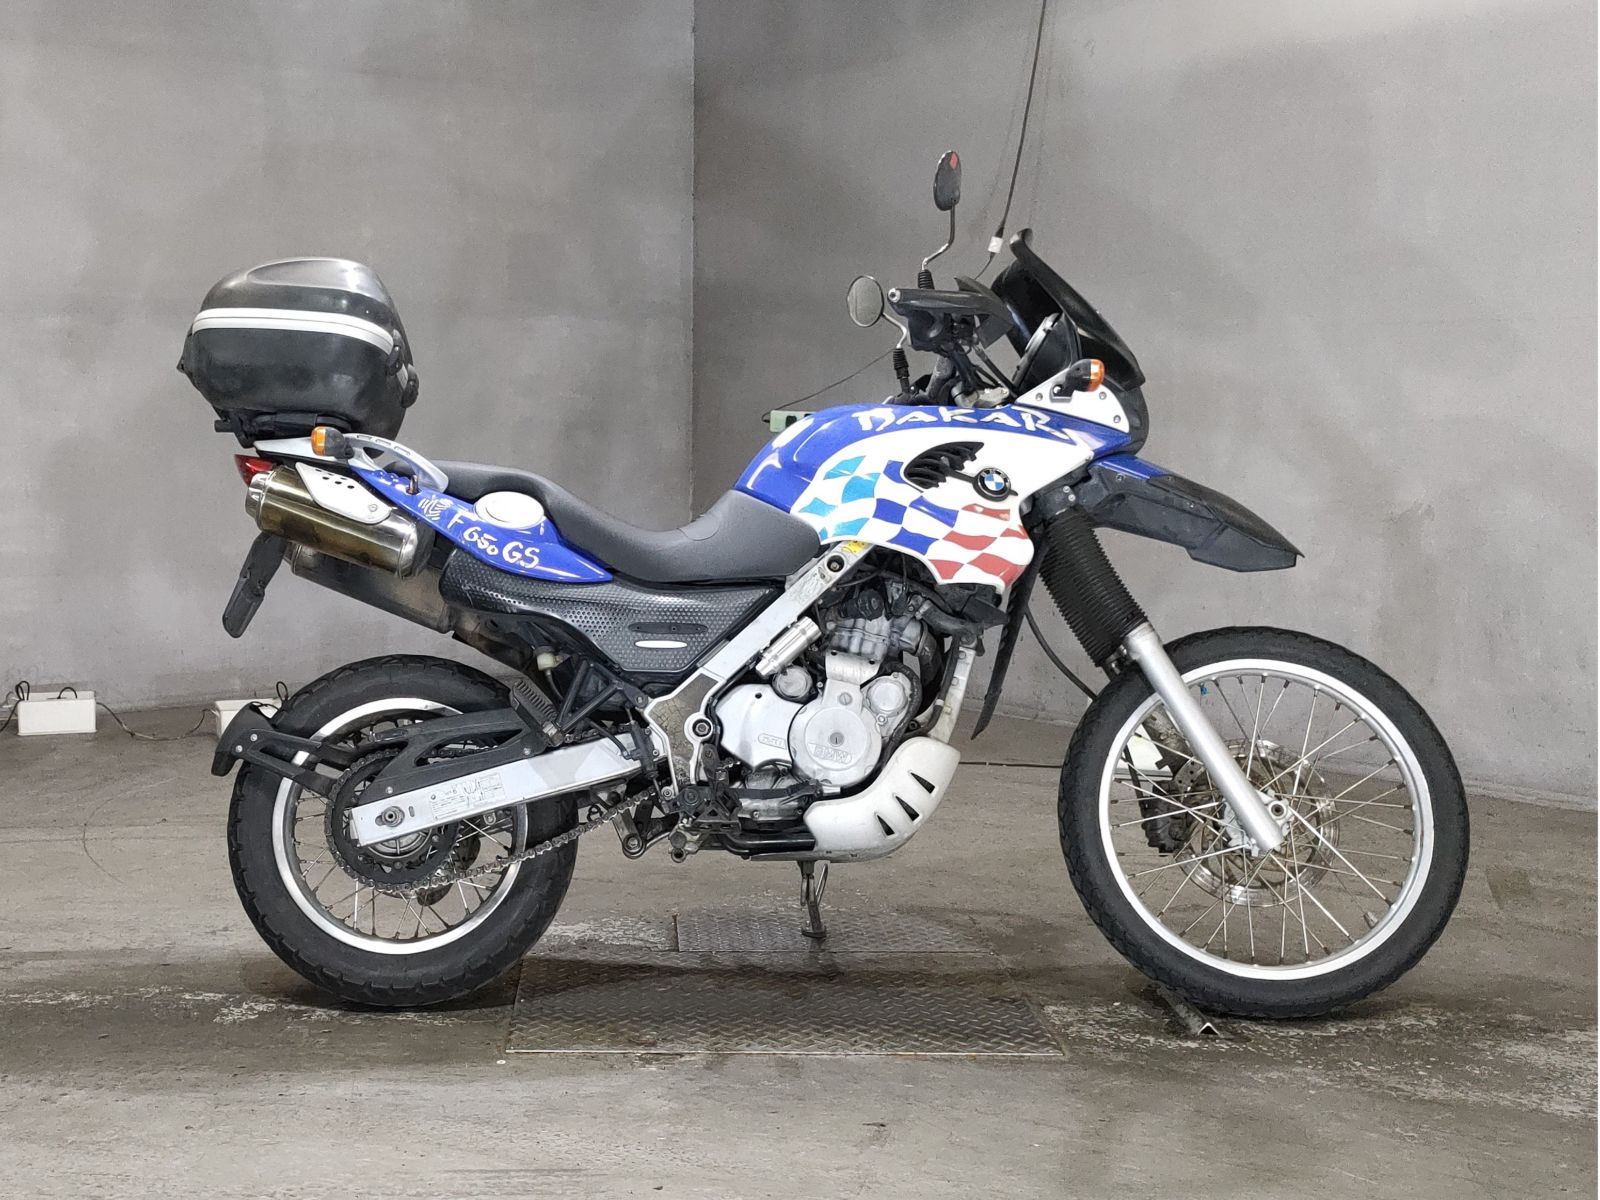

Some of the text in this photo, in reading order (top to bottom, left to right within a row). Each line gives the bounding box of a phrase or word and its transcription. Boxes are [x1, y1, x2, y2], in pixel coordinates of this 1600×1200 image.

[852, 405, 1075, 443] DAKAR
[447, 509, 540, 568] F 650 GS
